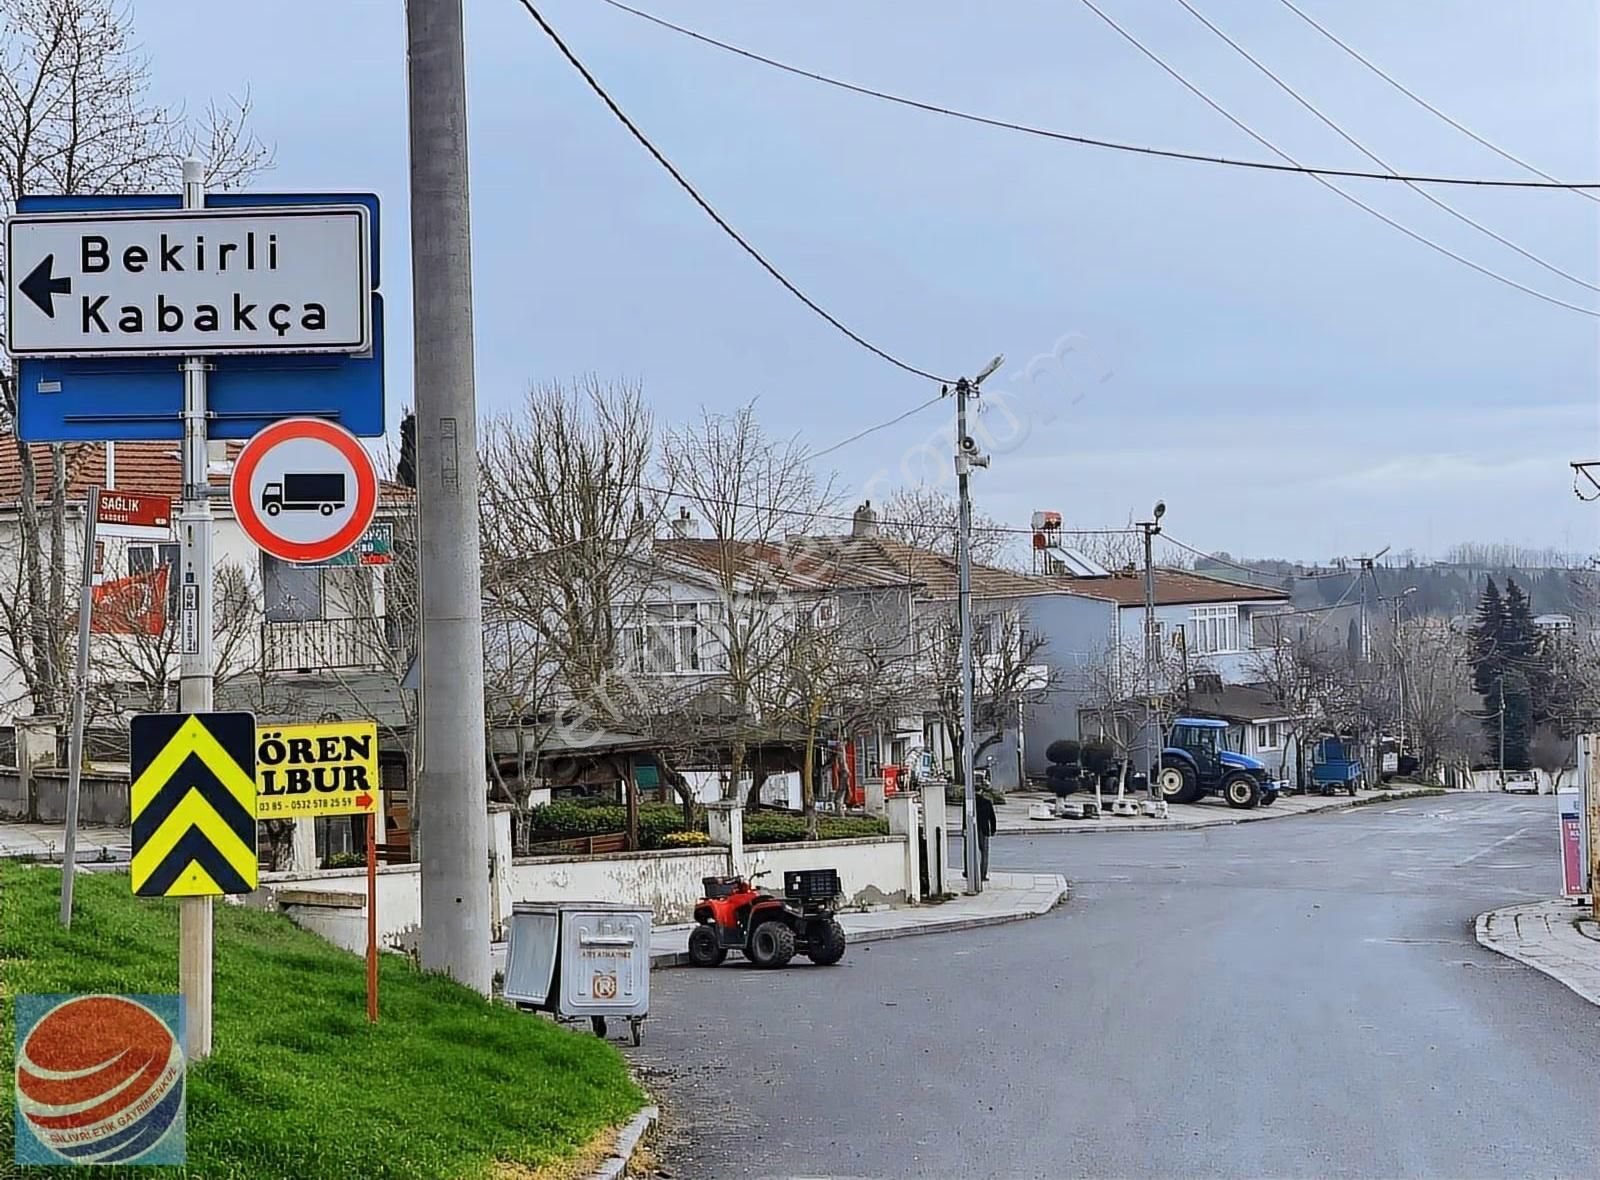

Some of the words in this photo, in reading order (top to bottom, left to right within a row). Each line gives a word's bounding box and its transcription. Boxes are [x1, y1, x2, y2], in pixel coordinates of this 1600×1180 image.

[80, 232, 279, 274] Bekirli
[81, 293, 327, 336] Kabakça
[101, 496, 139, 512] SAĞLIK
[256, 732, 372, 766] ÖREN
[256, 766, 371, 796] LBUR
